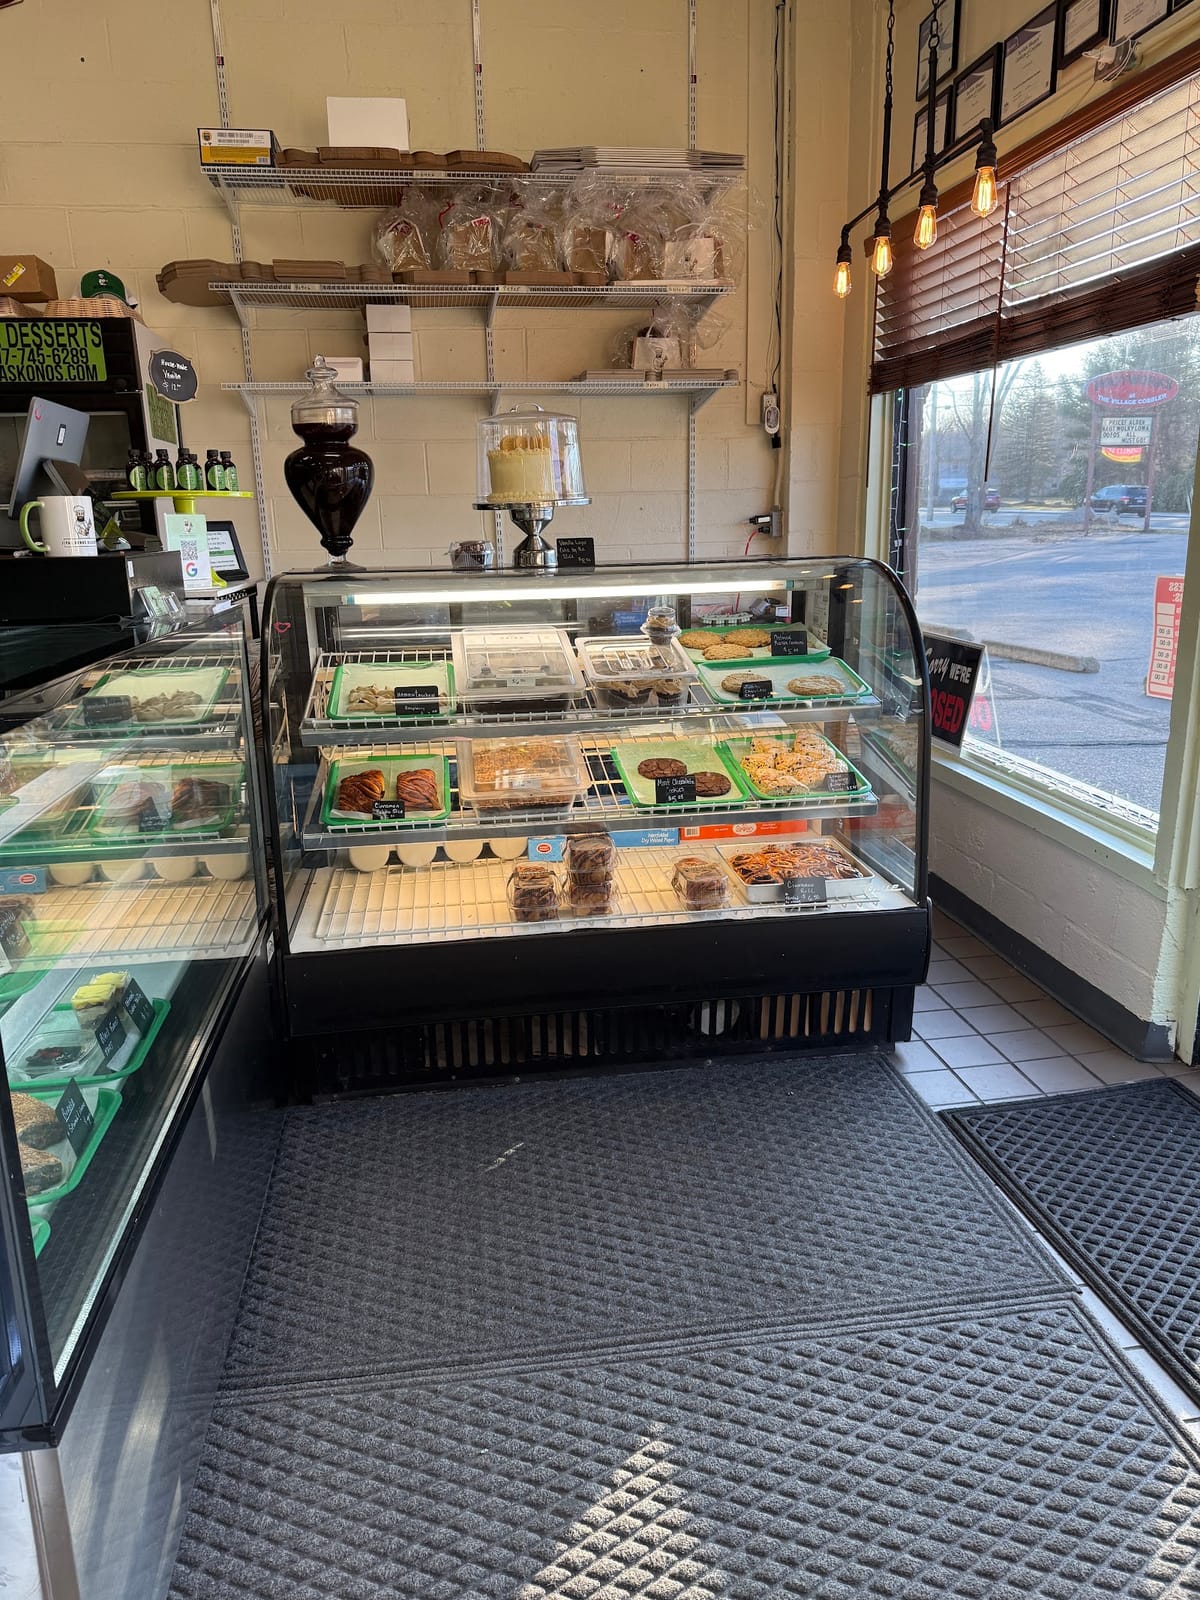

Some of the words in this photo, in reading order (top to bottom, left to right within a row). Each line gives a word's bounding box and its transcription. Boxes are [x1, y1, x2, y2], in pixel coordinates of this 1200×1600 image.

[5, 322, 102, 348] DESSERTS
[949, 662, 973, 685] WE'RE
[931, 686, 965, 734] OSED
[656, 778, 671, 787] Mint
